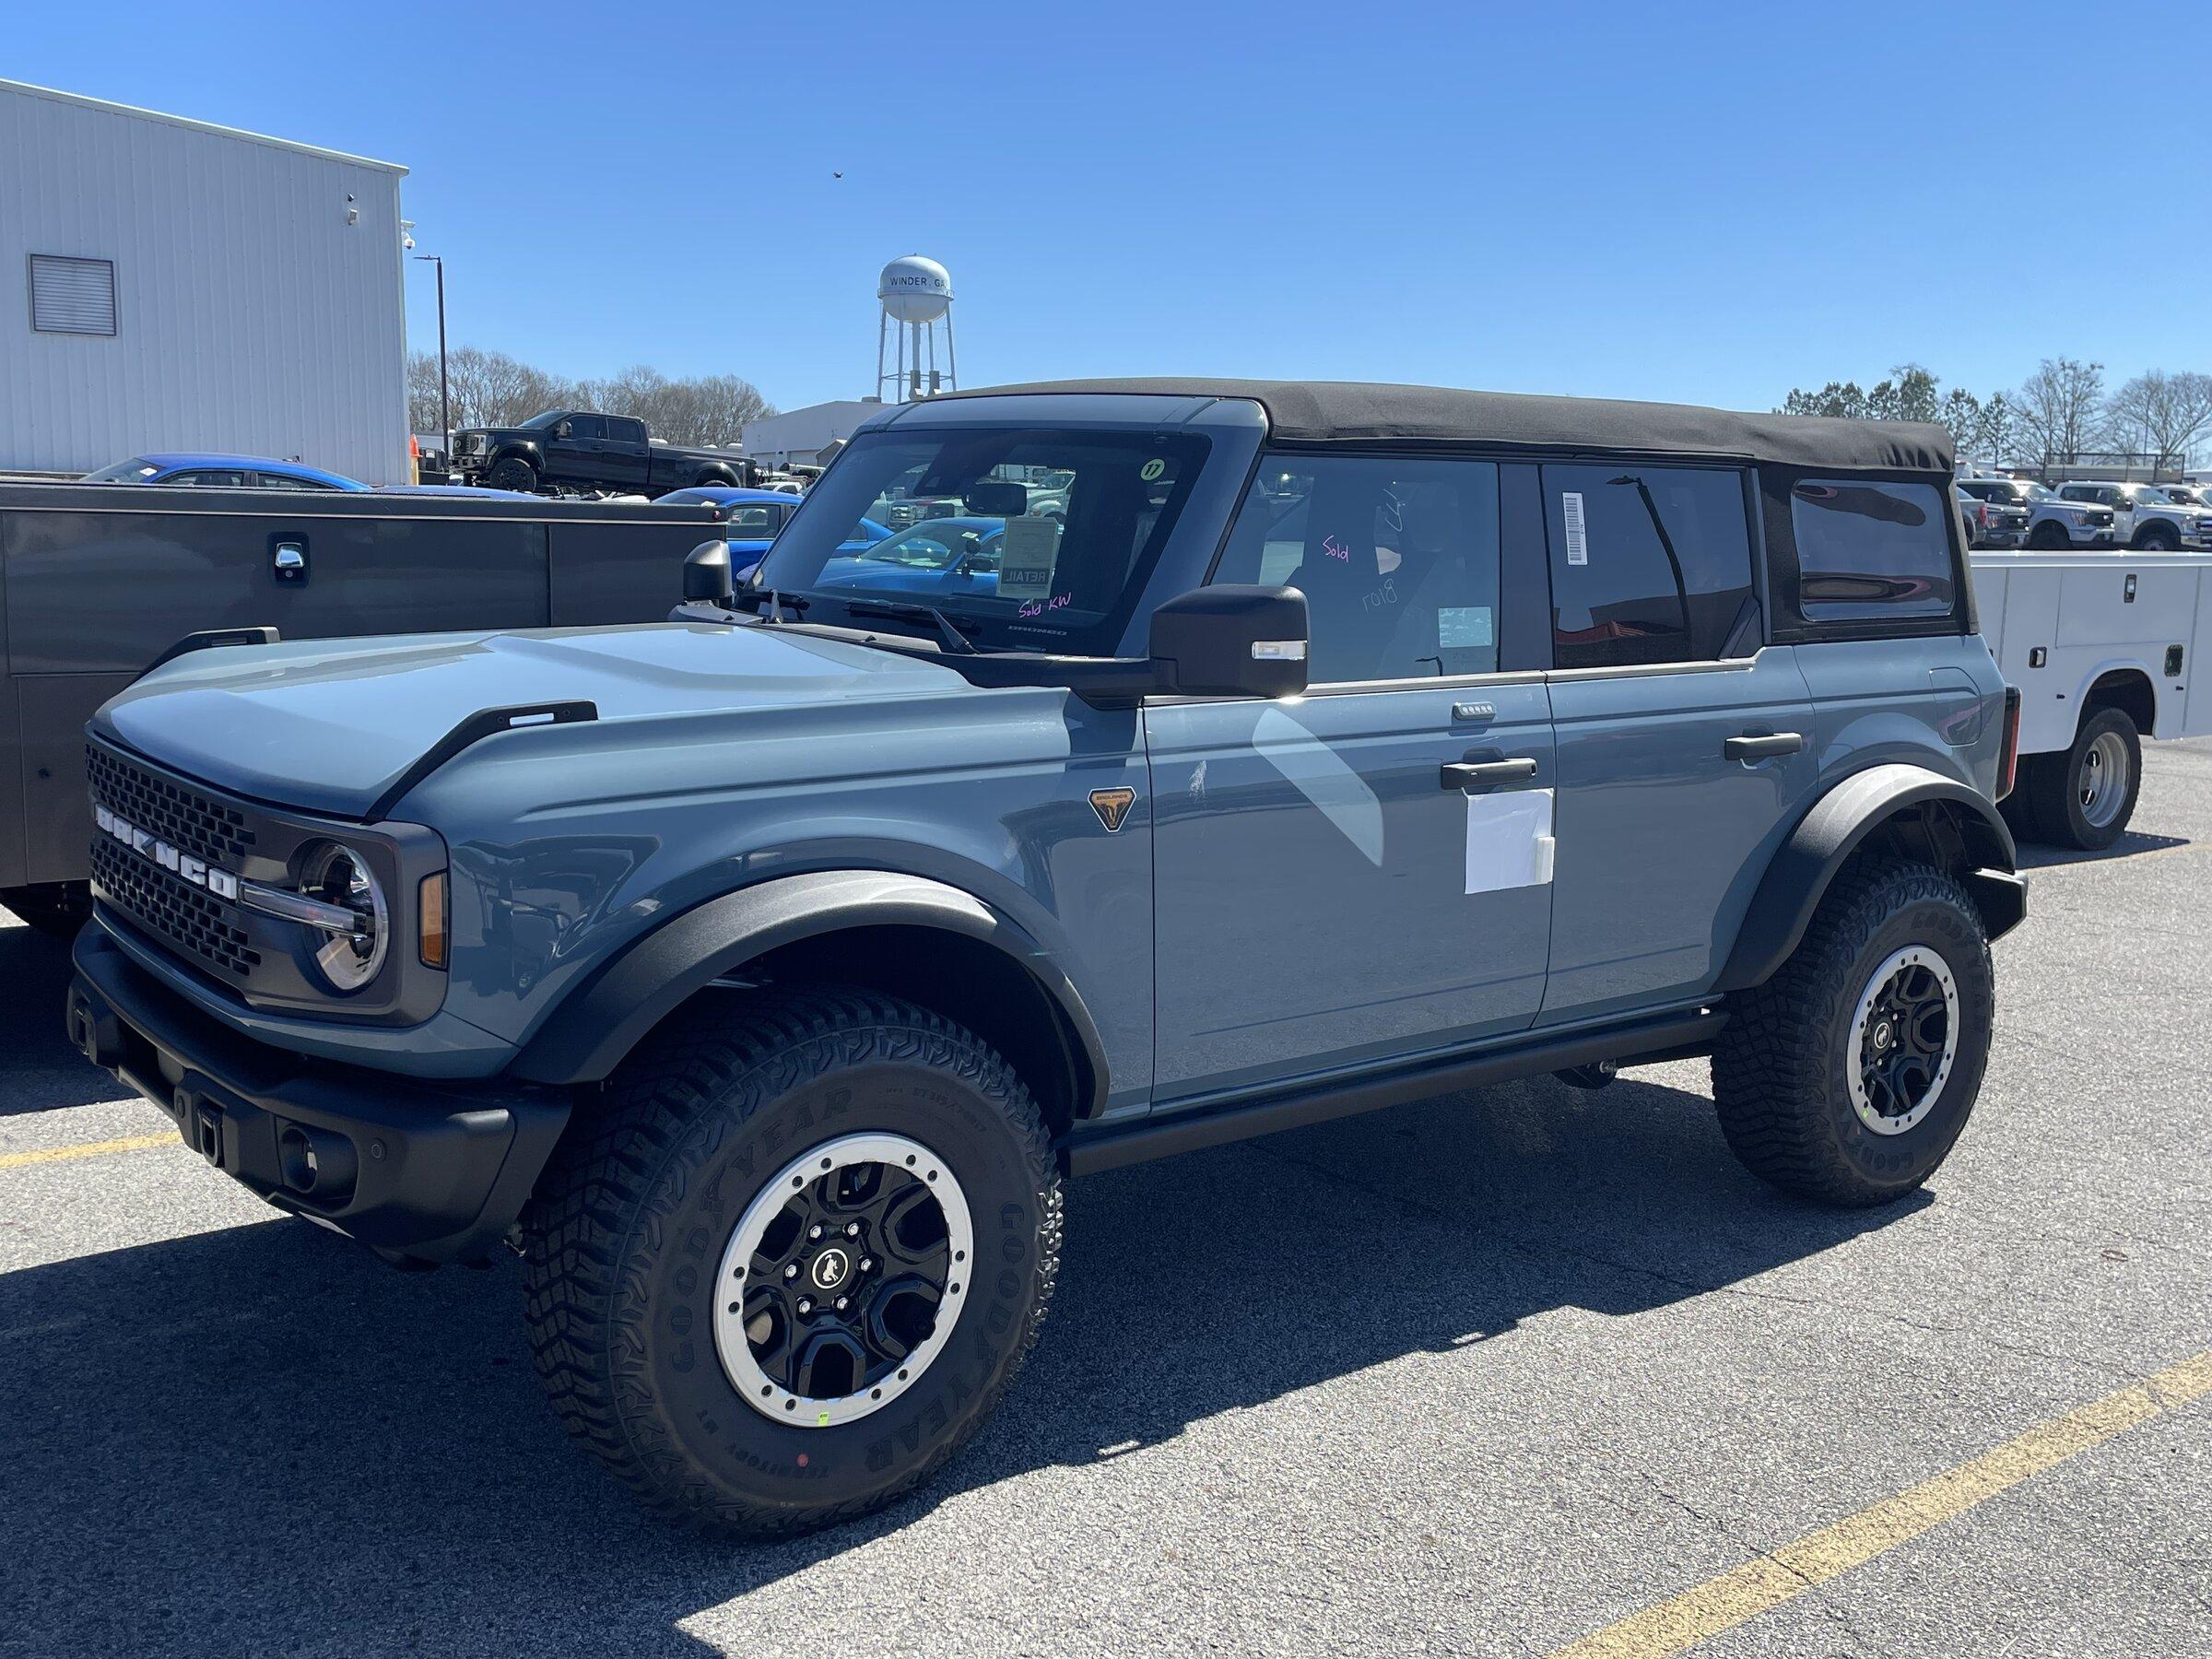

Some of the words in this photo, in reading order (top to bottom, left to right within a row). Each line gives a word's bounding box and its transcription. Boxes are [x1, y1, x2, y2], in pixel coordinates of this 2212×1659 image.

[1145, 463, 1160, 476] 17
[1323, 535, 1349, 563] Sold
[1018, 598, 1042, 619] Sold
[96, 803, 238, 900] BRONCO
